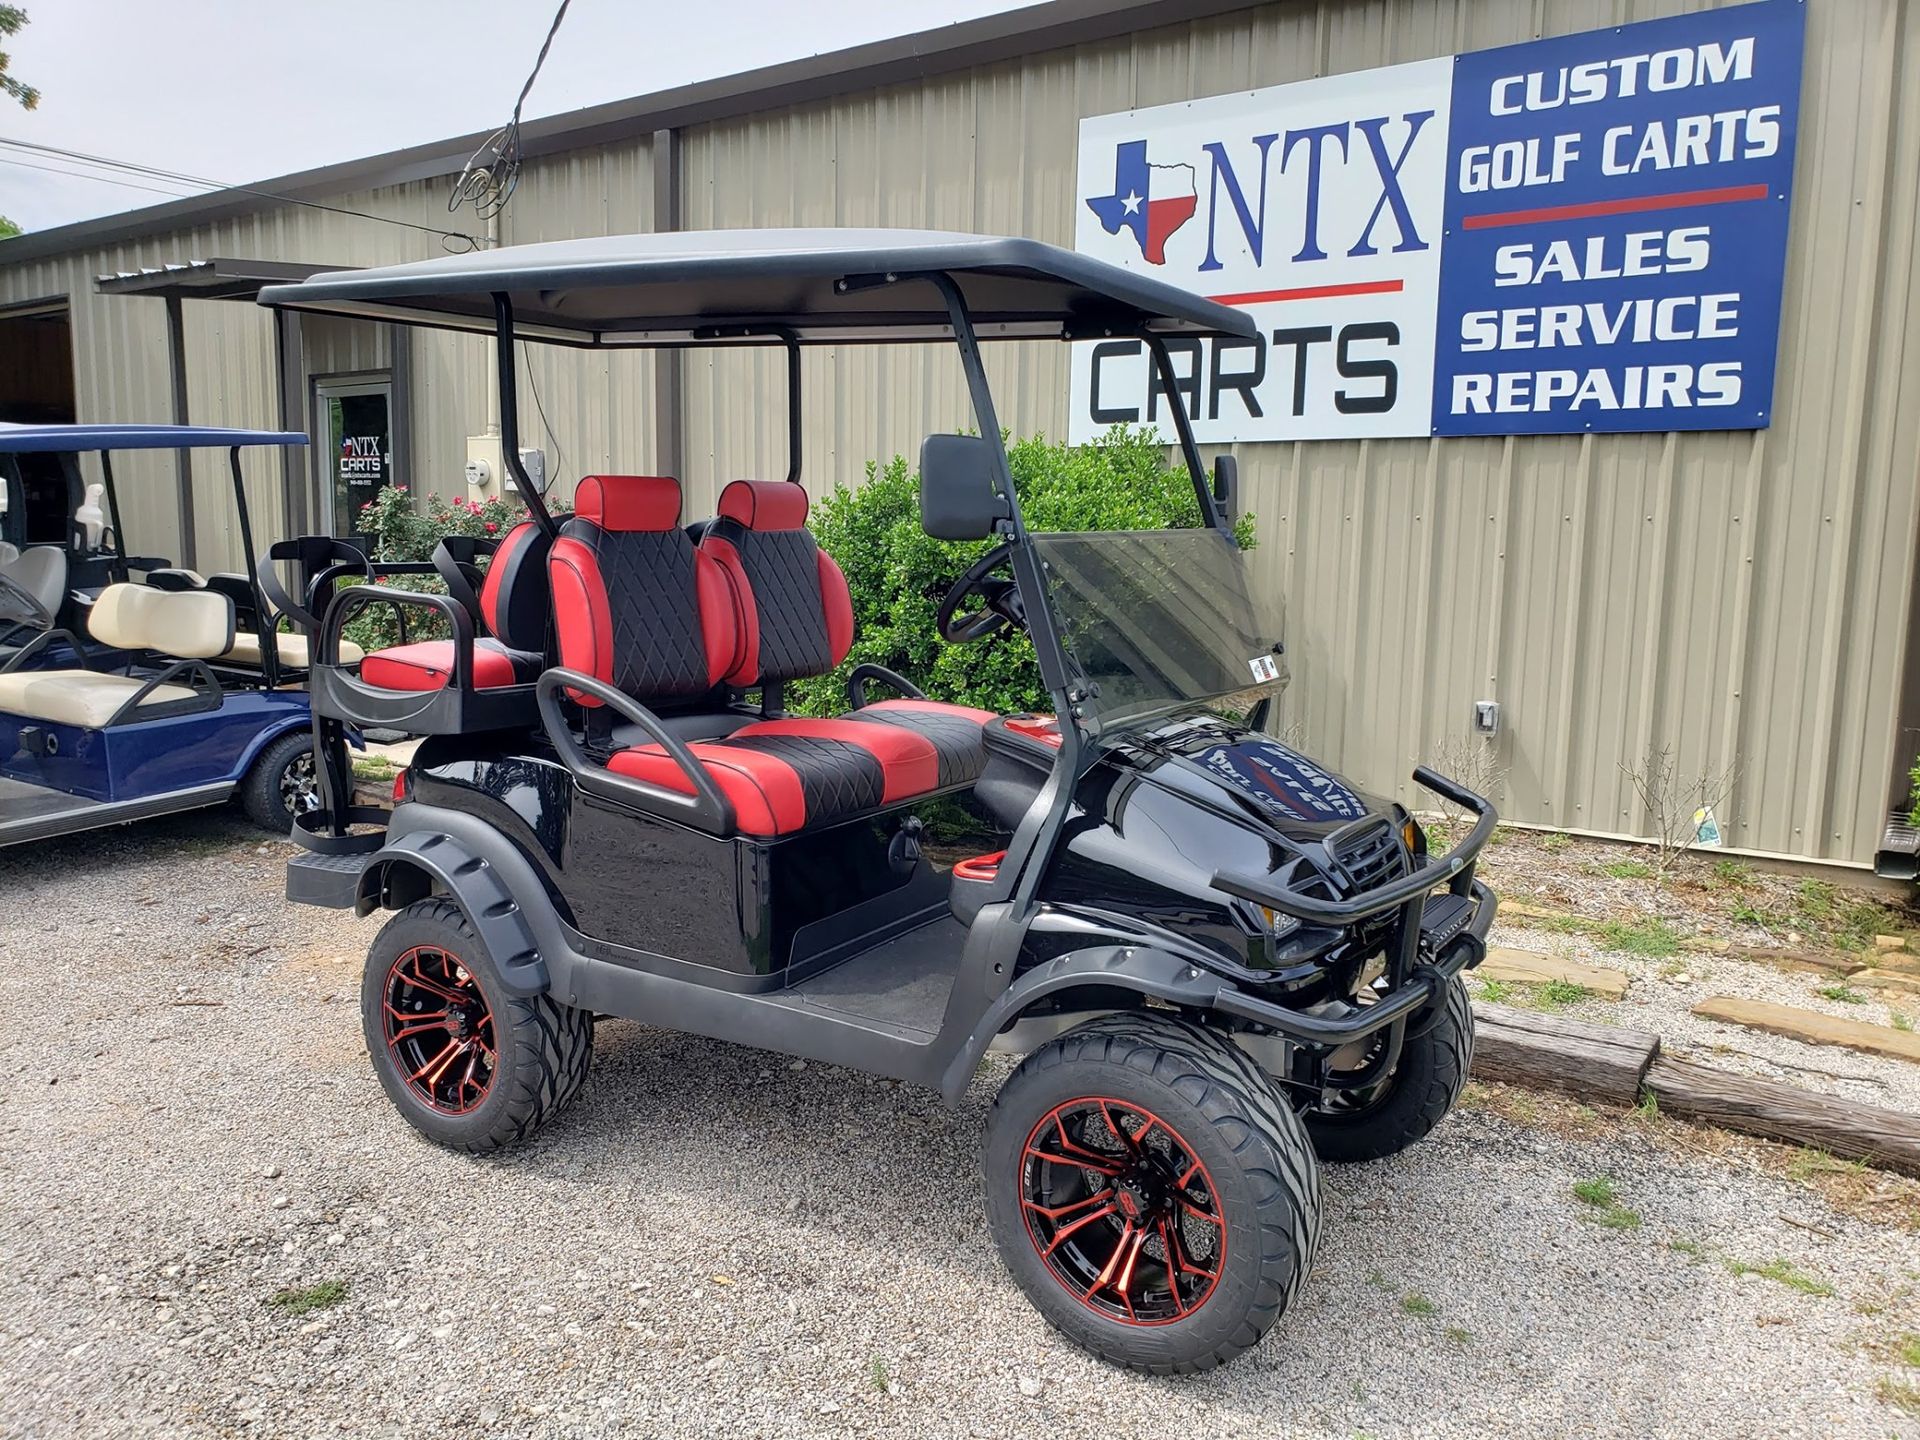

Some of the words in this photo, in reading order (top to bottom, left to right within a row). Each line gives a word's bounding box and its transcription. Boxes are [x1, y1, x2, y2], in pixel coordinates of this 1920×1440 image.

[1490, 37, 1755, 117] CUSTOM
[1459, 133, 1581, 194] GOLF
[1602, 105, 1780, 176] CARTS
[1198, 110, 1435, 272] NTX
[1495, 226, 1710, 287] SALES
[1461, 292, 1740, 352] SERVICE
[1090, 321, 1401, 425] CARTS
[1450, 362, 1742, 414] REPAIRS
[340, 457, 380, 471] CARTS
[351, 436, 380, 456] NTX
